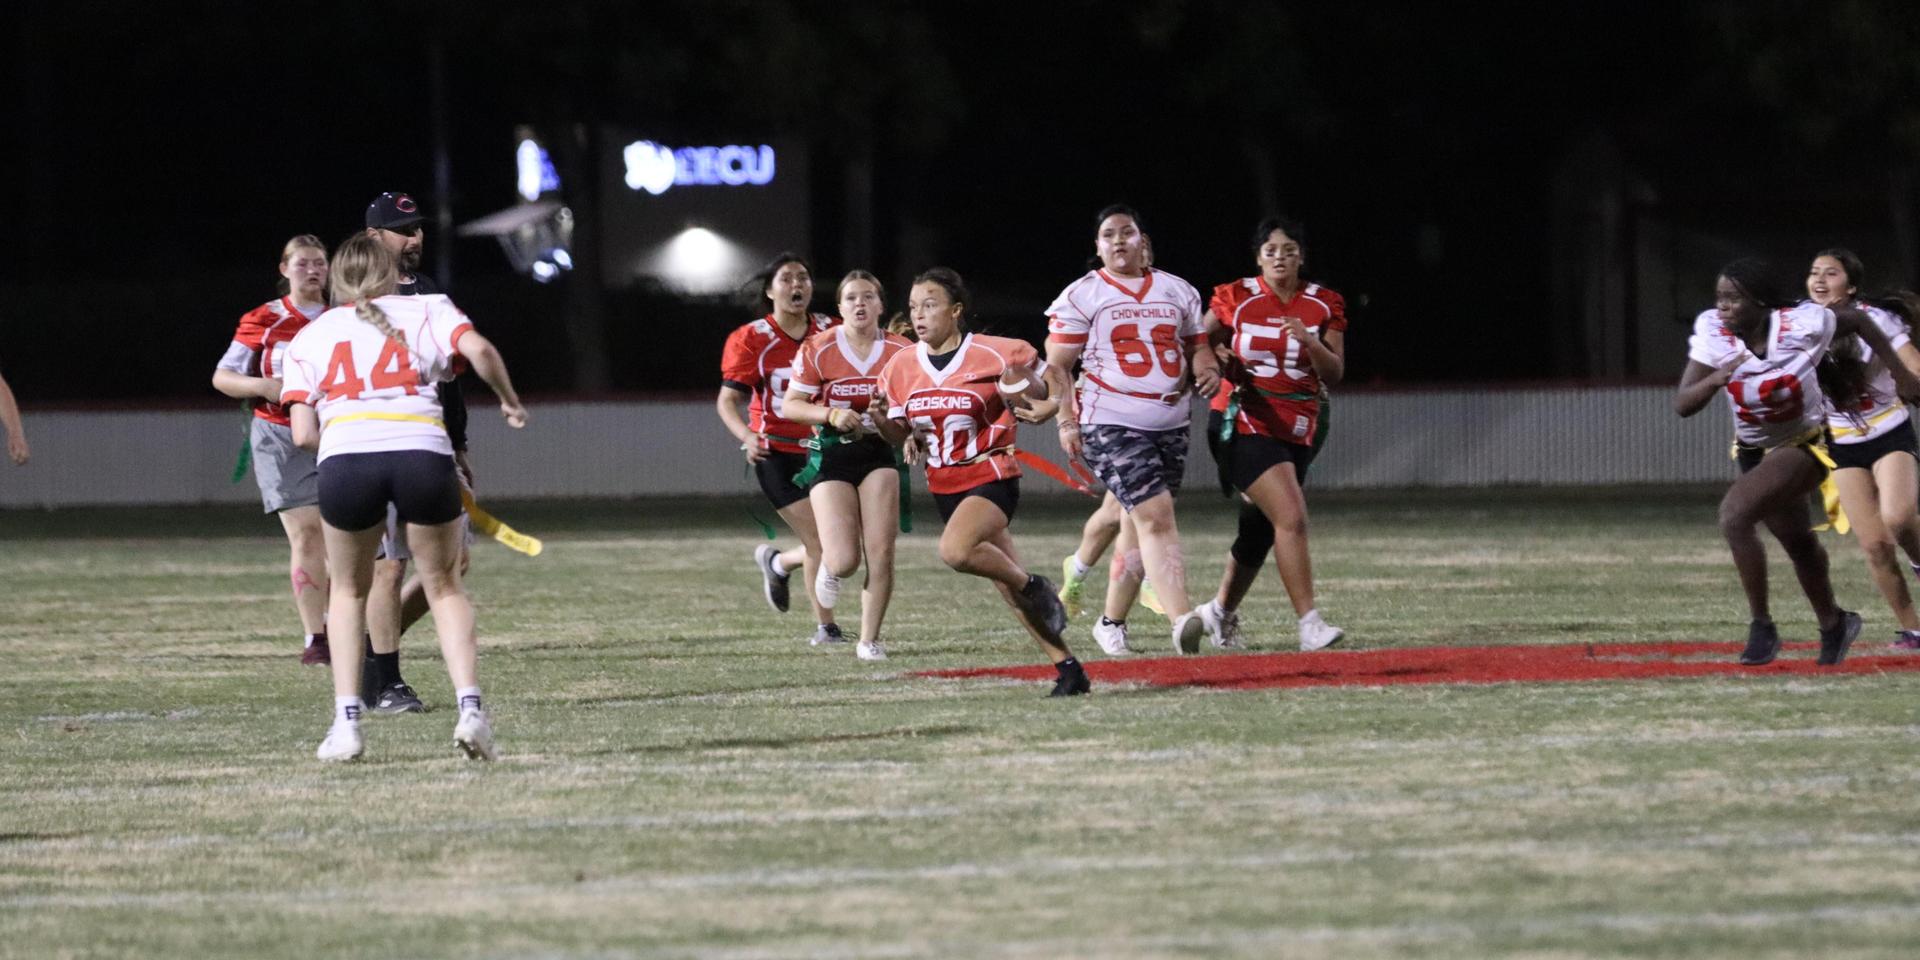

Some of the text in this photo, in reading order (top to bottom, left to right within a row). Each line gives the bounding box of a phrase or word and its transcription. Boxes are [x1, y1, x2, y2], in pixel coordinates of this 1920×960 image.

[1111, 308, 1177, 320] CHOWCHILLA
[1110, 323, 1182, 378] 66
[319, 329, 421, 402] 44
[831, 384, 879, 396] REDSK
[908, 396, 972, 411] REDSKINS
